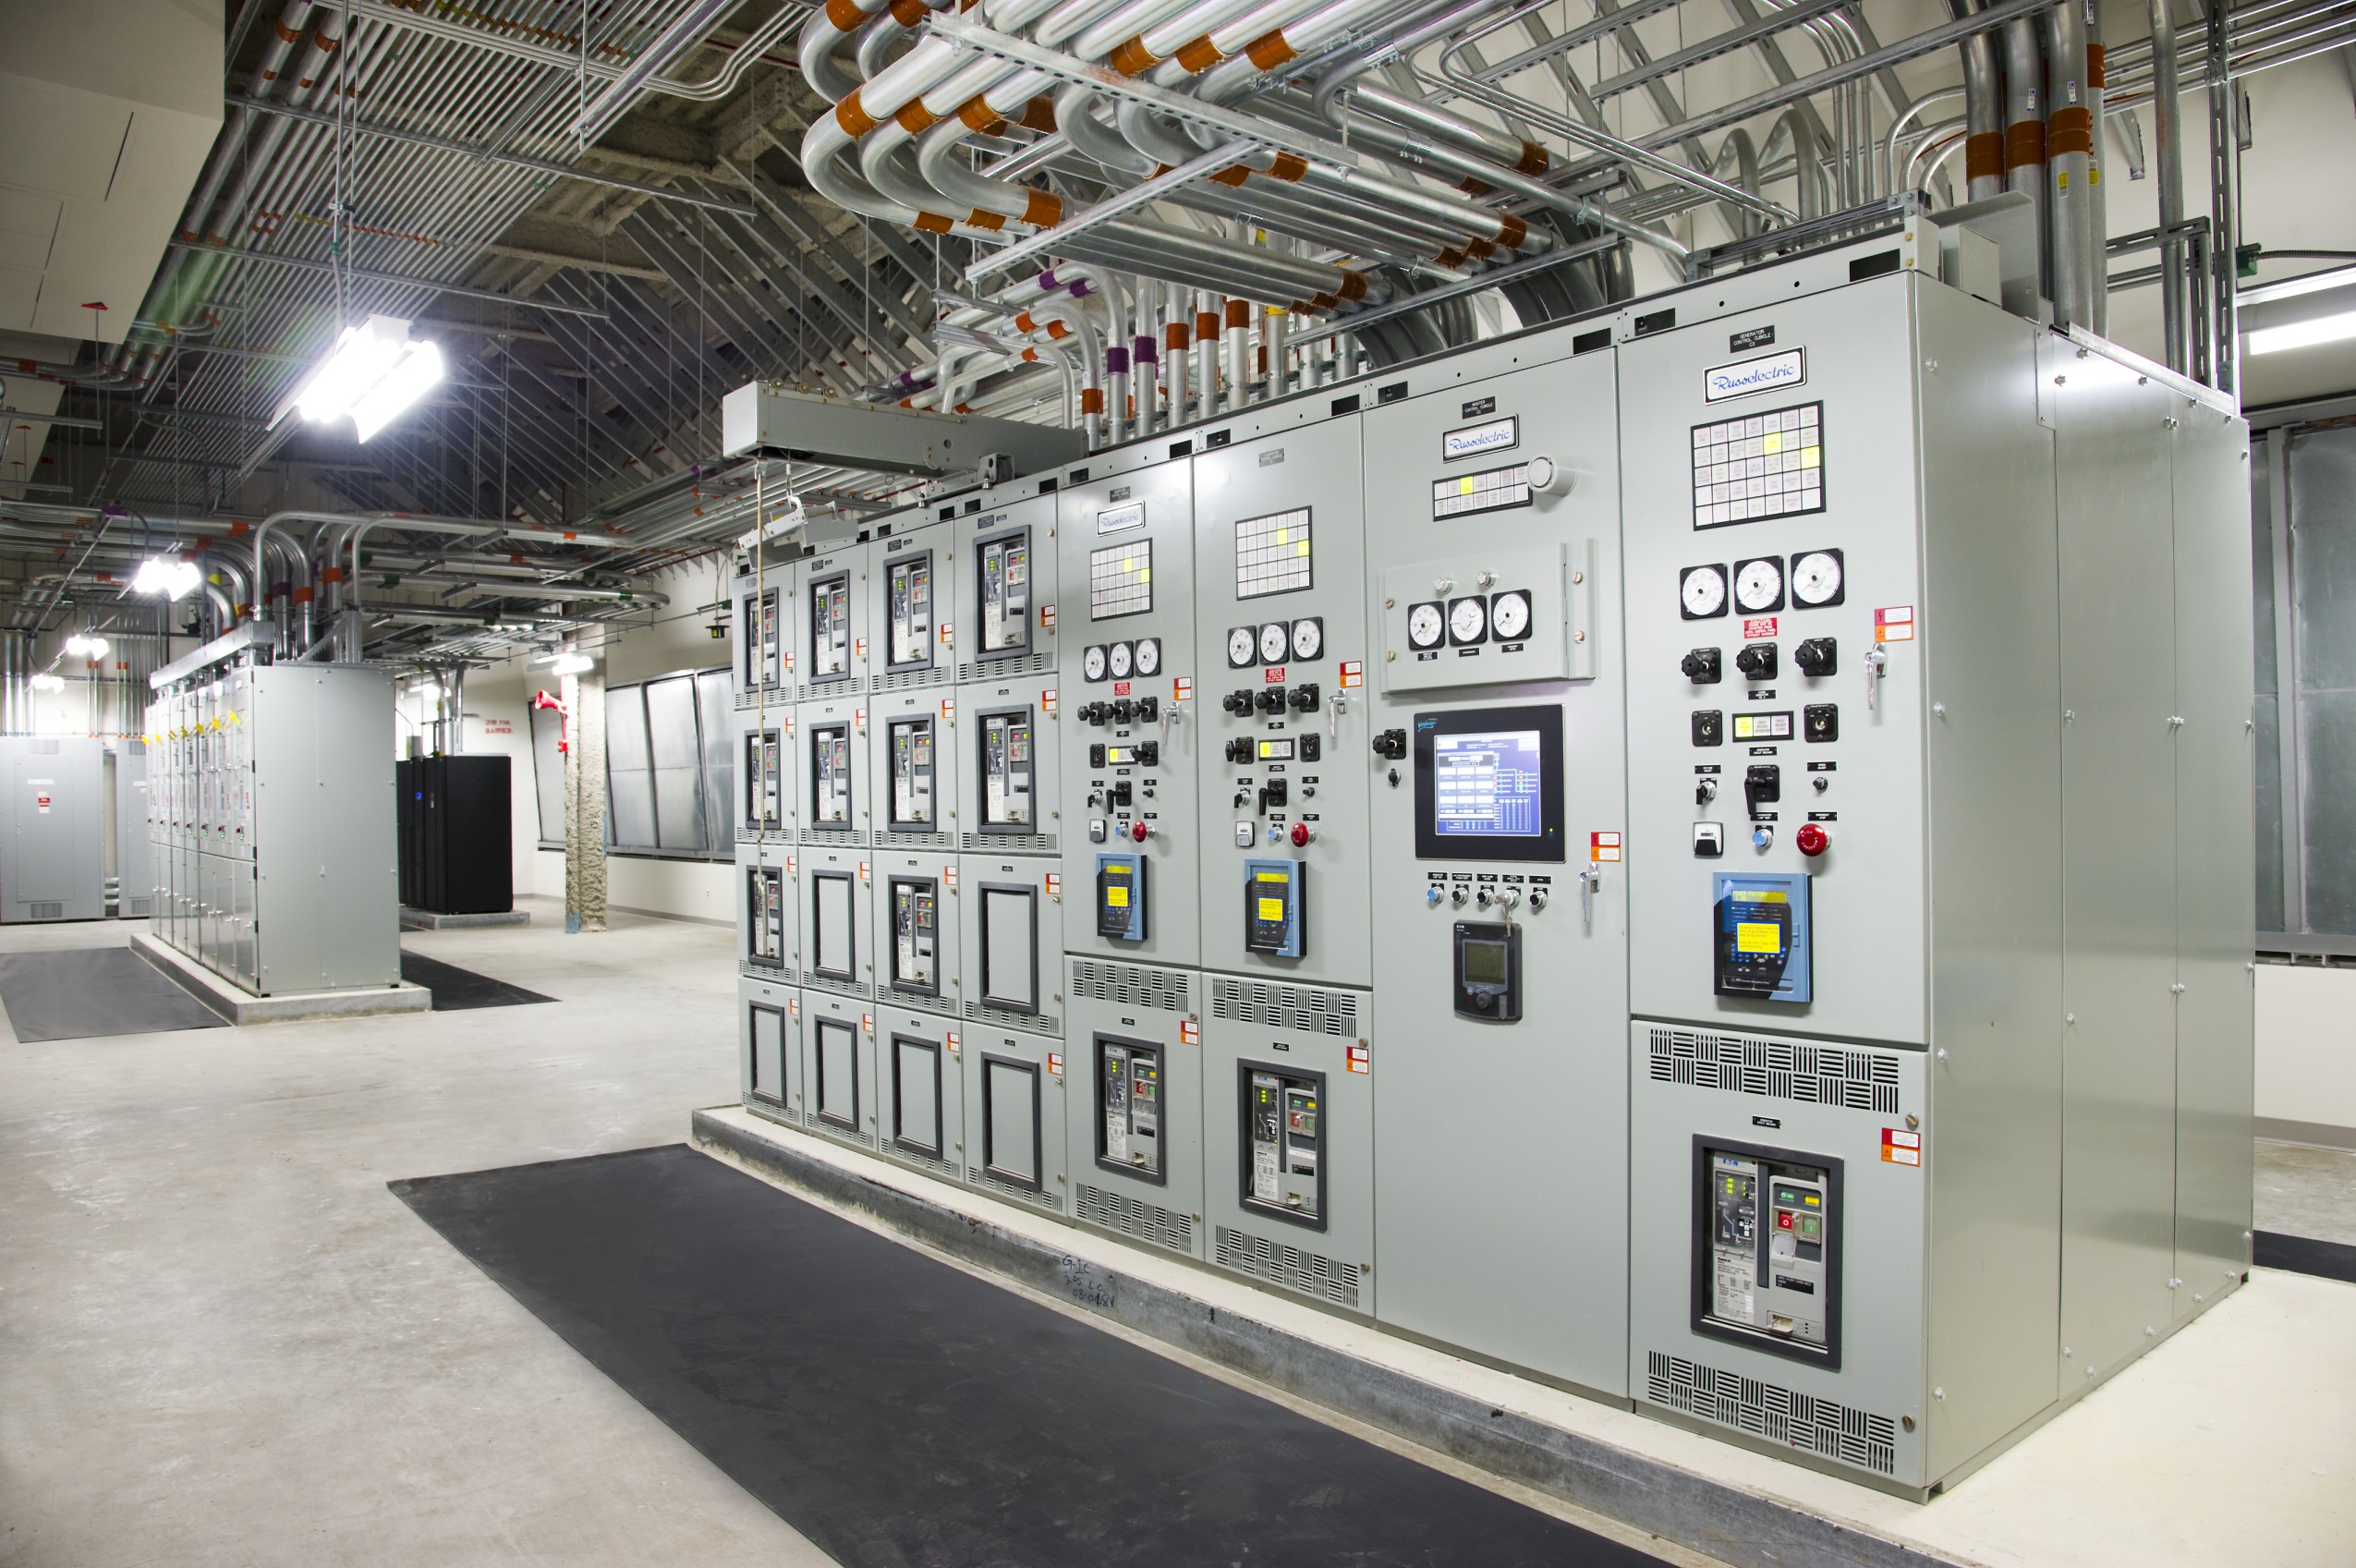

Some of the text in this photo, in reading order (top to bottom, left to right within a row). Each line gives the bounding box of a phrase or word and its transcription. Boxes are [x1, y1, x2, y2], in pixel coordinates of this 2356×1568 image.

[1733, 333, 1771, 346] CONTROL CUBICLE
[1739, 329, 1765, 339] GENERATOR
[1712, 364, 1796, 390] Russelectric
[1449, 430, 1511, 451] Russelectric
